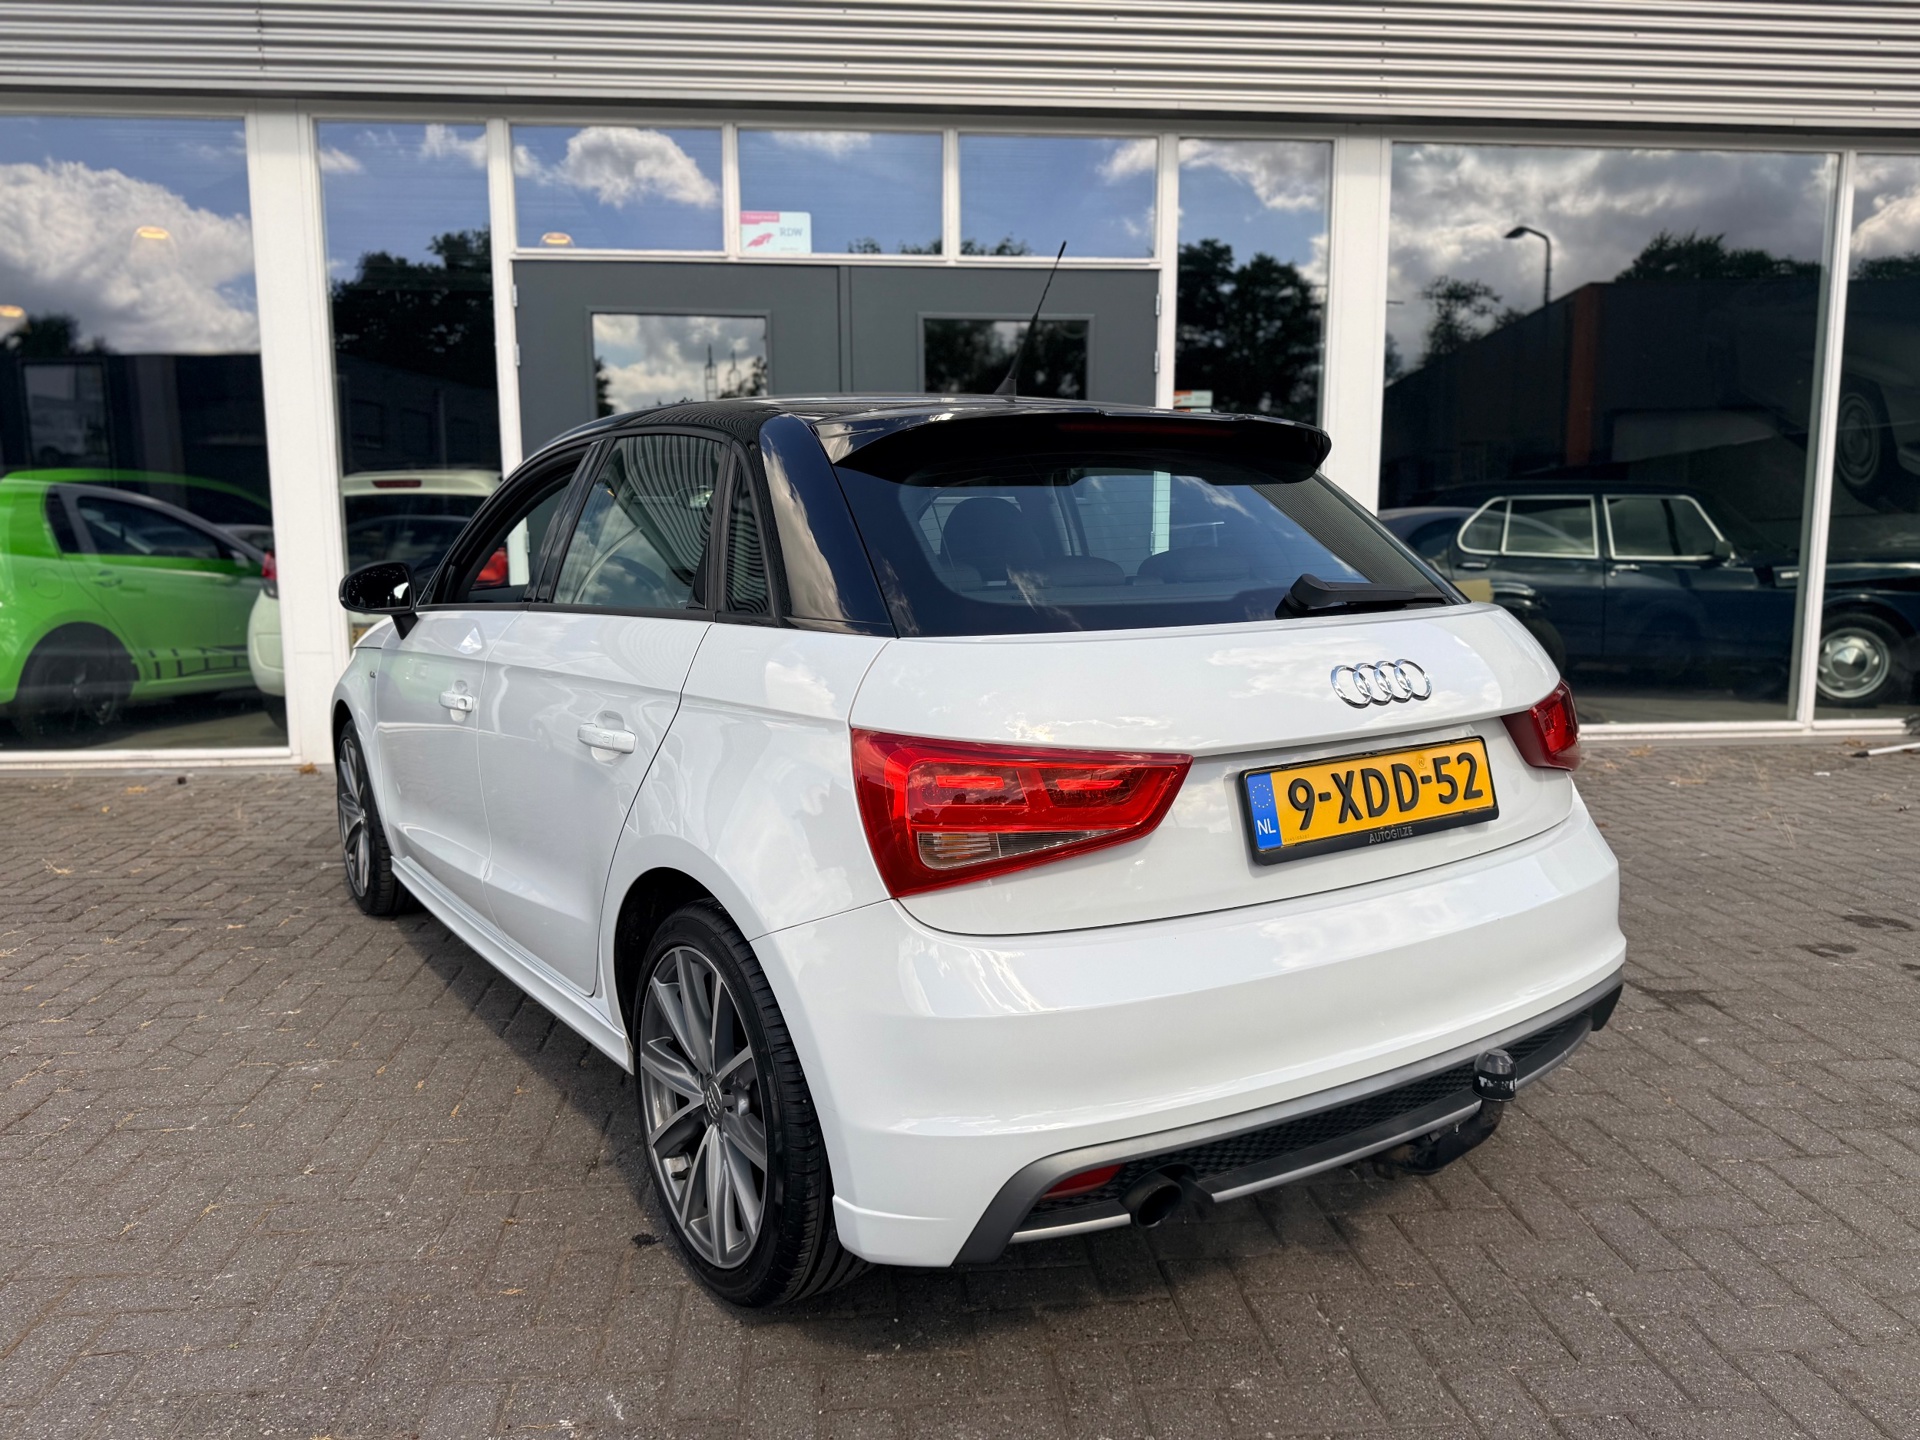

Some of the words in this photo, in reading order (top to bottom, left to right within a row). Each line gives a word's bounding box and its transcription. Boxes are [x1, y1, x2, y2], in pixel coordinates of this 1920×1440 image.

[1287, 752, 1483, 831] 9-XDD-52
[1256, 818, 1277, 836] NL
[1368, 826, 1413, 844] AUTOGILZE
